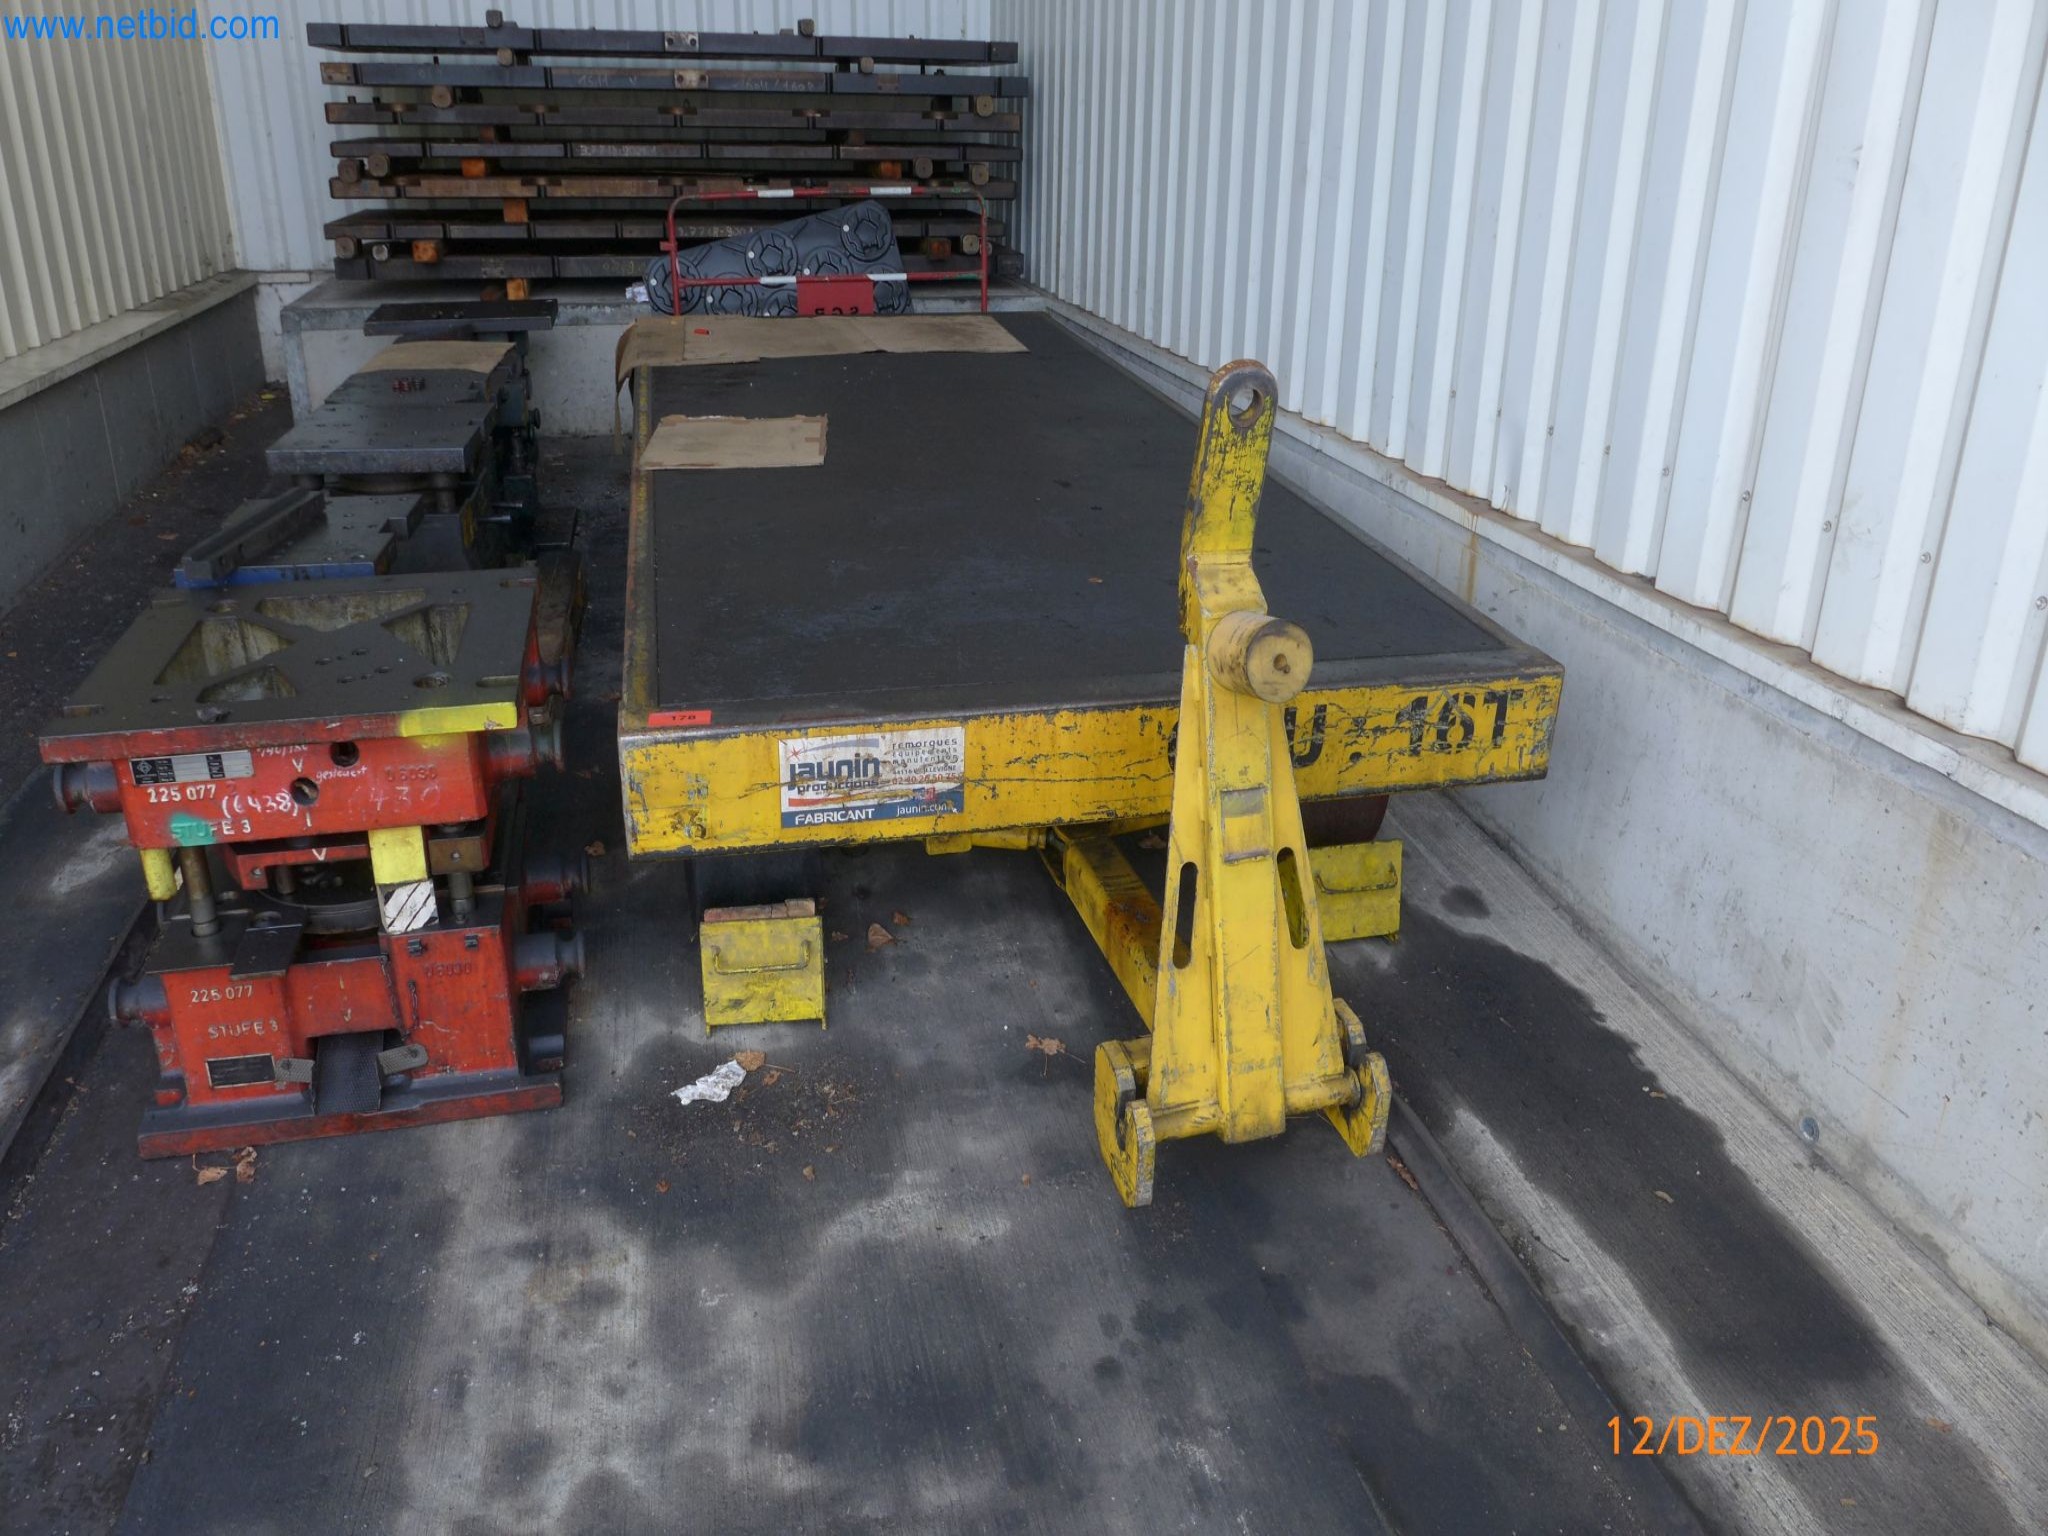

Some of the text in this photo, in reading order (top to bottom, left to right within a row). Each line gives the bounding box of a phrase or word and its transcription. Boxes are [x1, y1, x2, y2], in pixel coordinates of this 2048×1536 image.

[892, 738, 958, 750] remorques
[787, 753, 880, 791] jaunin
[147, 784, 217, 804] 225 077
[241, 819, 252, 834] 3
[795, 808, 876, 826] FABRICANT
[190, 984, 253, 1003] 225 077
[208, 1021, 265, 1040] STUFE
